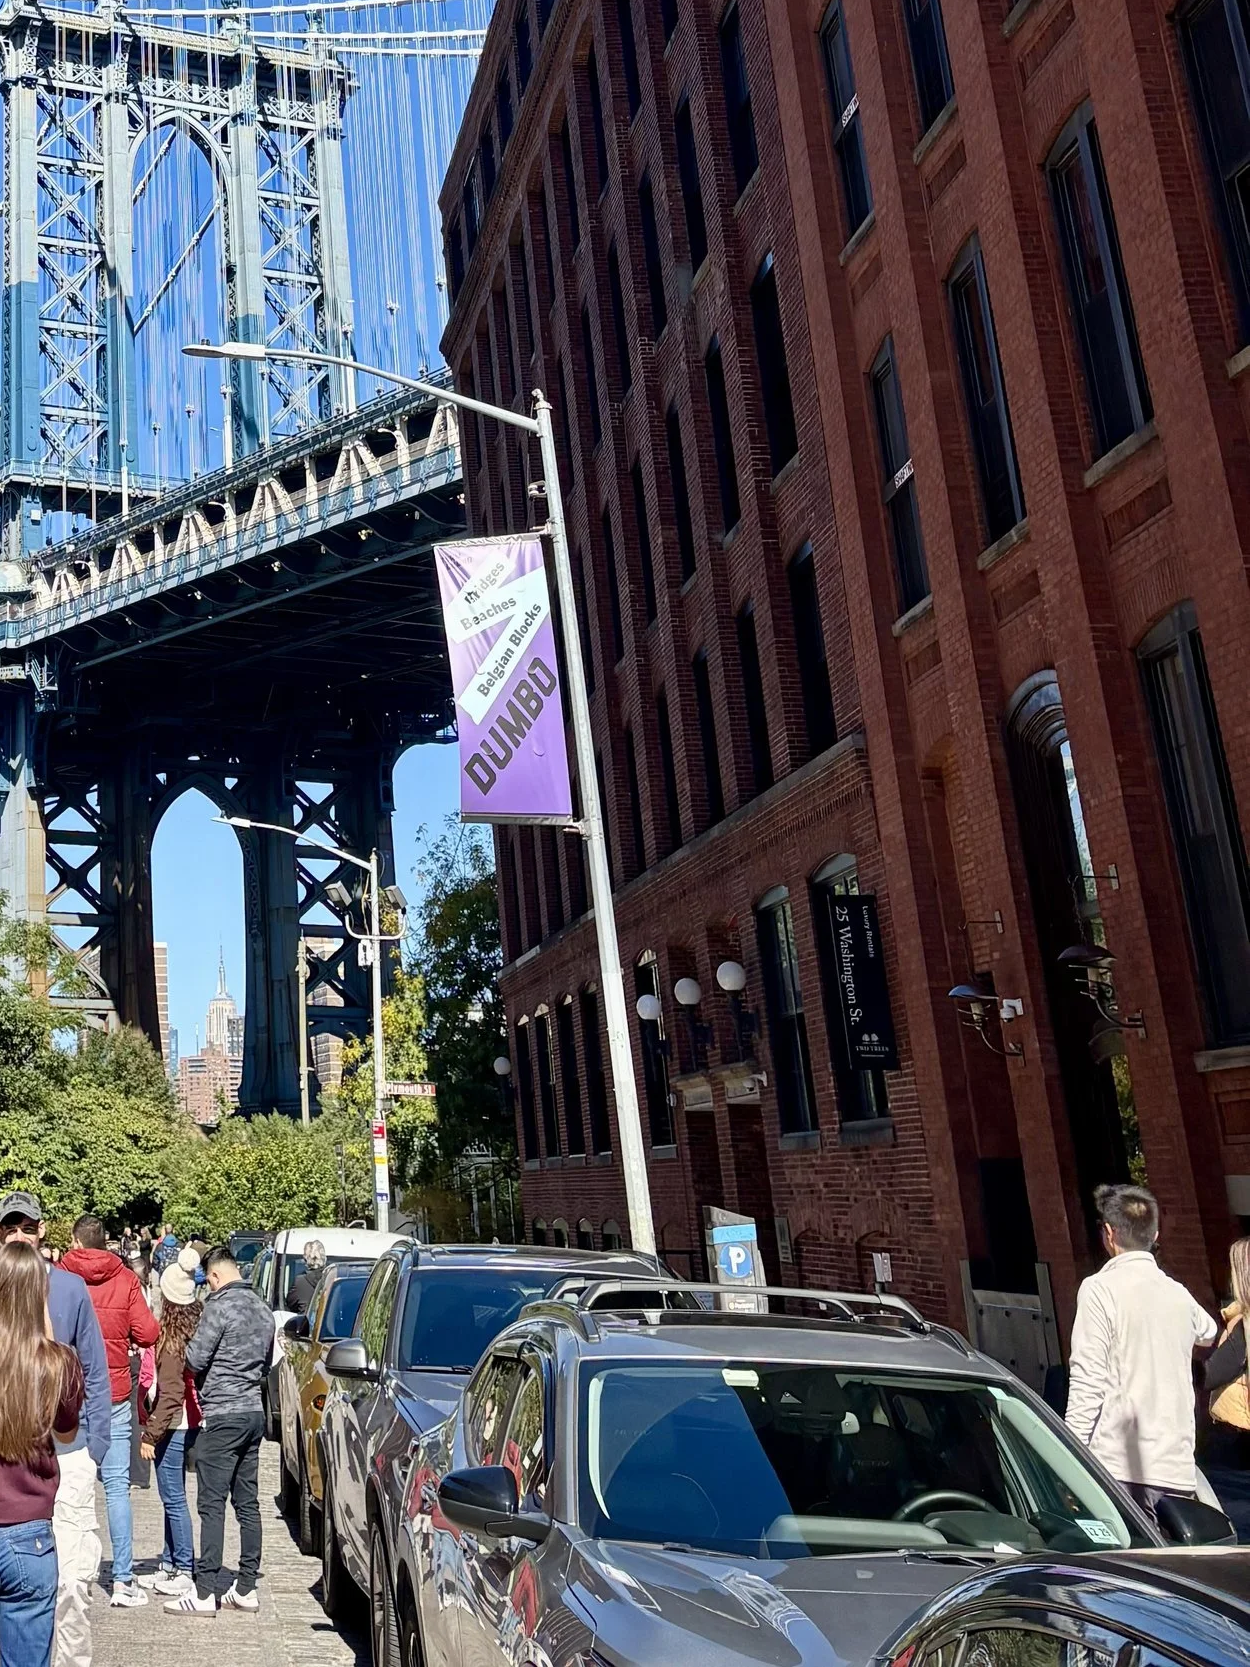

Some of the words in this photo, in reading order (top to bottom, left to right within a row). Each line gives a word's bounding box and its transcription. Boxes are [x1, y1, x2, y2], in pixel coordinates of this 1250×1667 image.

[460, 597, 517, 631] Beaches
[477, 648, 514, 697] Belgian
[509, 603, 542, 647] Blocks
[463, 657, 556, 796] DUMBO
[836, 906, 849, 922] 25
[866, 930, 875, 958] Rentals
[839, 925, 856, 1004] Washington
[850, 1008, 862, 1025] St.
[728, 1246, 746, 1273] P
